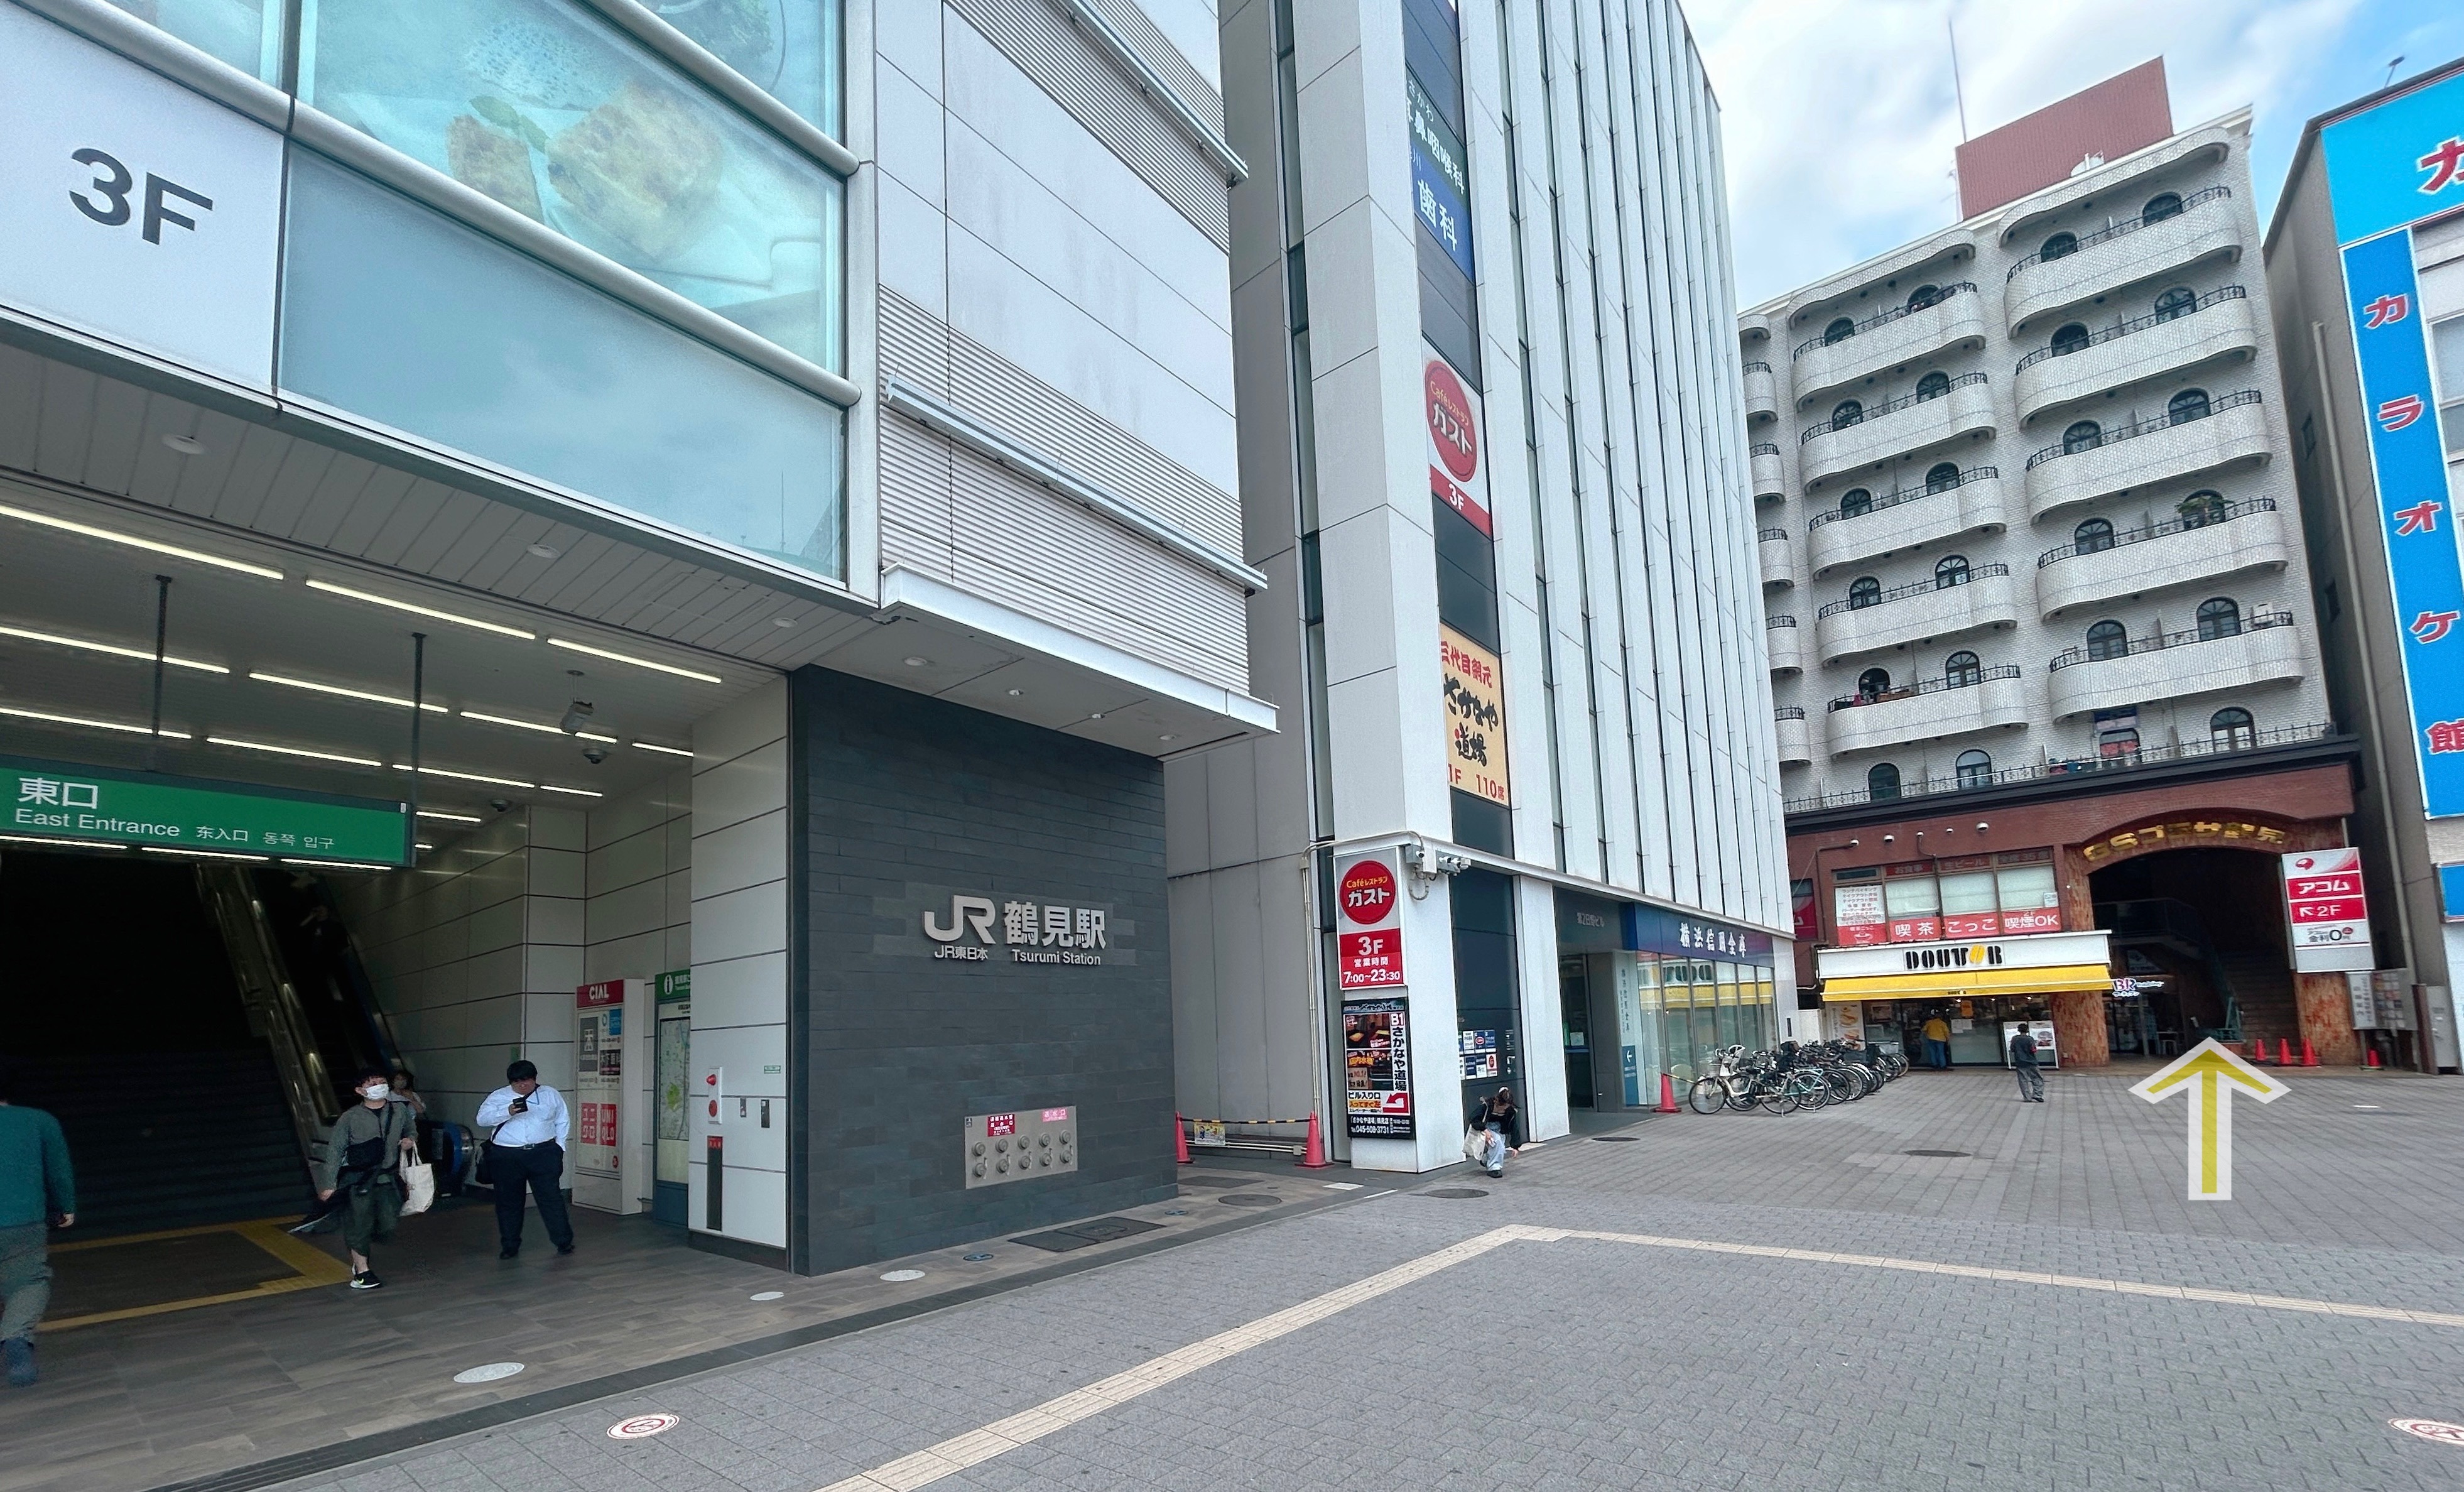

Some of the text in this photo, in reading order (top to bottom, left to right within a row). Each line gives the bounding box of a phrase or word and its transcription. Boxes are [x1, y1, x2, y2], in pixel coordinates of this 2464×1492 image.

[69, 148, 214, 245] 3F
[1417, 179, 1458, 252] 歯科
[1433, 402, 1473, 456] ガスト
[1448, 483, 1464, 511] 3F
[18, 777, 99, 809] 東口
[15, 809, 181, 838] East Entrance
[195, 825, 249, 842] 东入口
[262, 832, 335, 849] 동쪽 입구
[1346, 876, 1388, 888] Caféレストラン
[2298, 879, 2350, 895] アコム
[1349, 888, 1391, 908] ガスト
[2317, 905, 2341, 917] 2F
[924, 895, 1107, 949] JR 鶴見駅
[1895, 922, 1934, 937] 喫茶
[1948, 918, 1996, 933] こっこ
[2004, 915, 2059, 929] 喫煙OK
[934, 945, 988, 961] JR東日本
[1358, 936, 1384, 956] 3F
[1012, 949, 1101, 966] Tsurumi Station
[1354, 957, 1389, 968] 営業時間
[1906, 944, 2002, 969] DOUTOR
[589, 984, 609, 1000] CIAL
[1391, 1013, 1404, 1026] B1
[1392, 1027, 1407, 1091] さかなや道場
